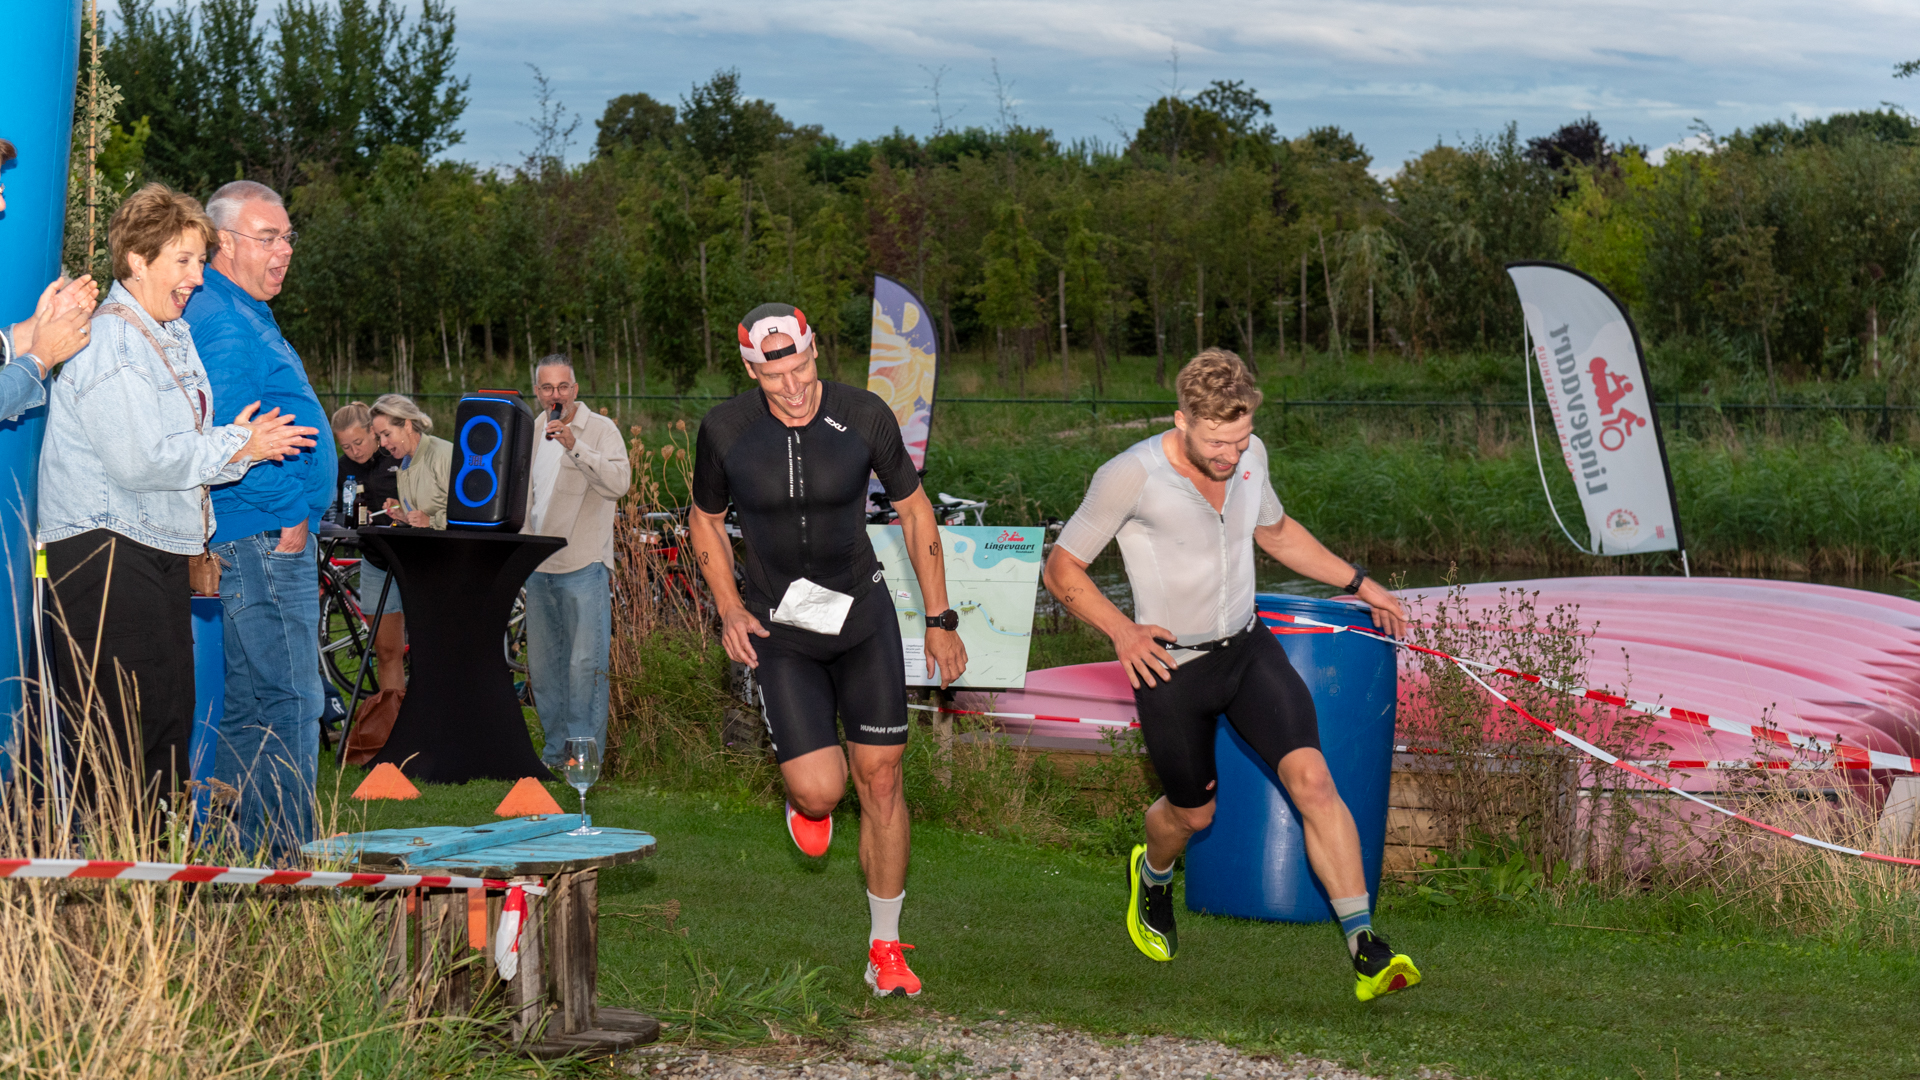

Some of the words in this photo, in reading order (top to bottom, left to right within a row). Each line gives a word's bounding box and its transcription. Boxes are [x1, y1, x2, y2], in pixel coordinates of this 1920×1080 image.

[468, 455, 485, 468] JBL
[984, 542, 1036, 552] Lingevaart
[698, 551, 710, 567] 18
[860, 724, 886, 733] HUMAN
